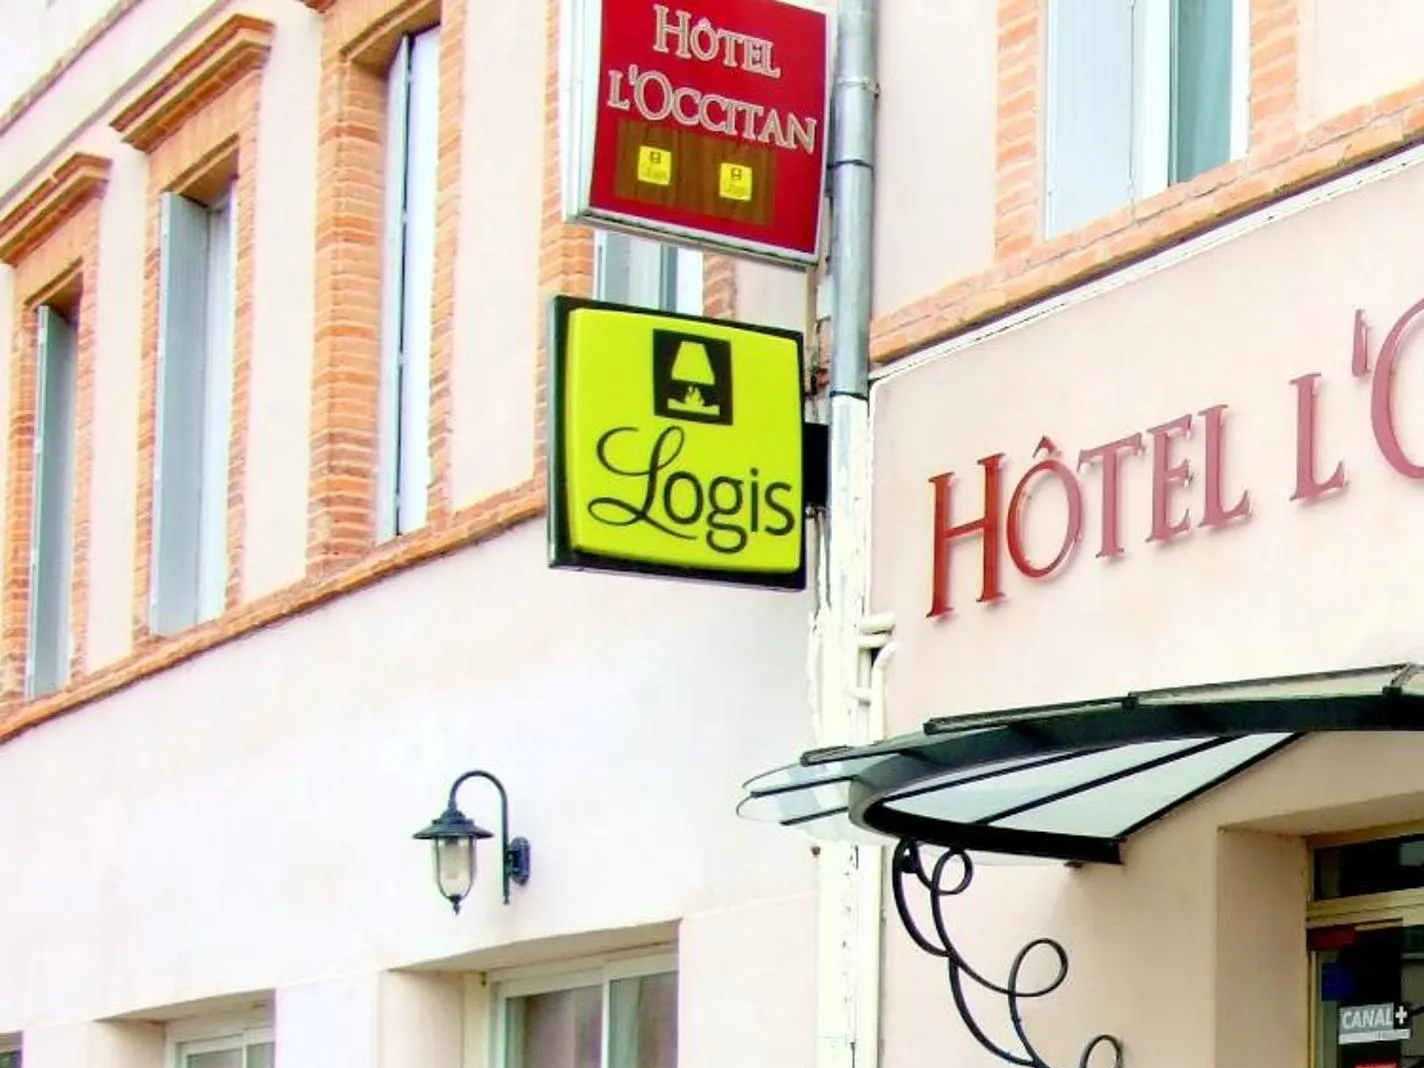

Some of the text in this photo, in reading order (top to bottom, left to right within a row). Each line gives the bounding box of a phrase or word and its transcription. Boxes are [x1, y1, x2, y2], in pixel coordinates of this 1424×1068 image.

[652, 3, 781, 79] HÔTEL
[607, 65, 817, 155] L'OCCITAN
[587, 425, 796, 555] Logis
[925, 403, 1251, 619] HÔTEL
[1342, 1005, 1408, 1030] CANAL+
